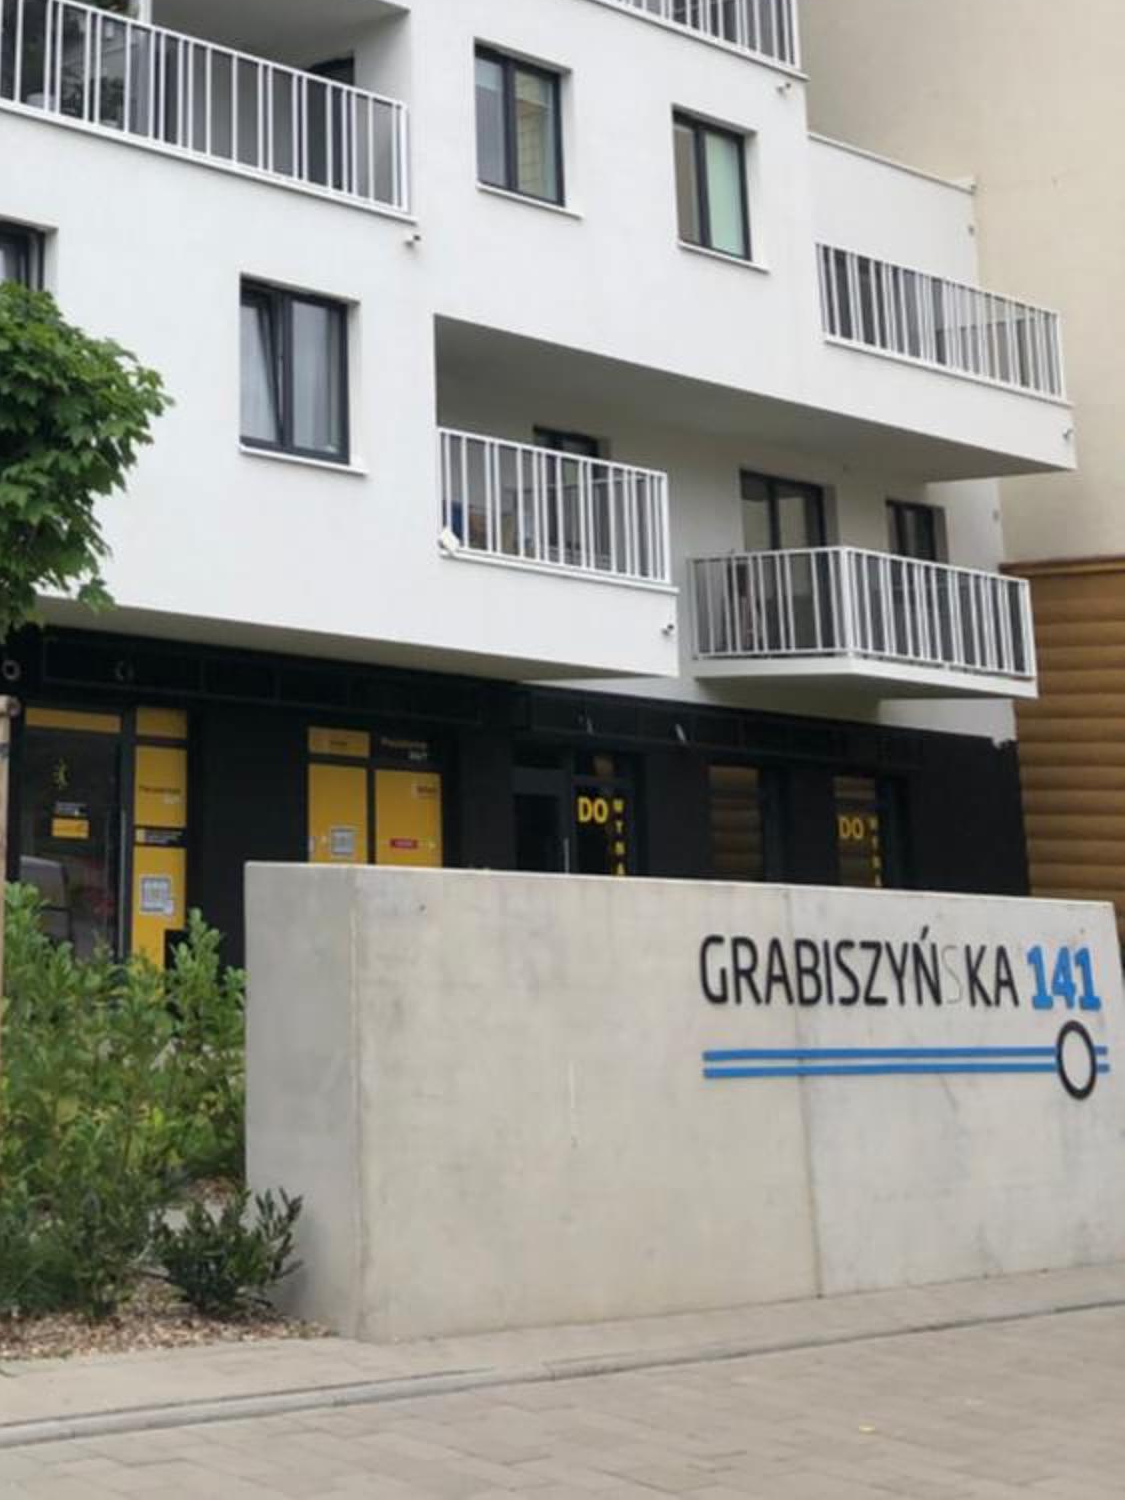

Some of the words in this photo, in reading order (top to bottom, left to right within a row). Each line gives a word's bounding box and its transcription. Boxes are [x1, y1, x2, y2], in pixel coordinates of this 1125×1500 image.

[577, 796, 609, 824] DO
[838, 816, 865, 840] DO
[1026, 944, 1102, 1011] 141
